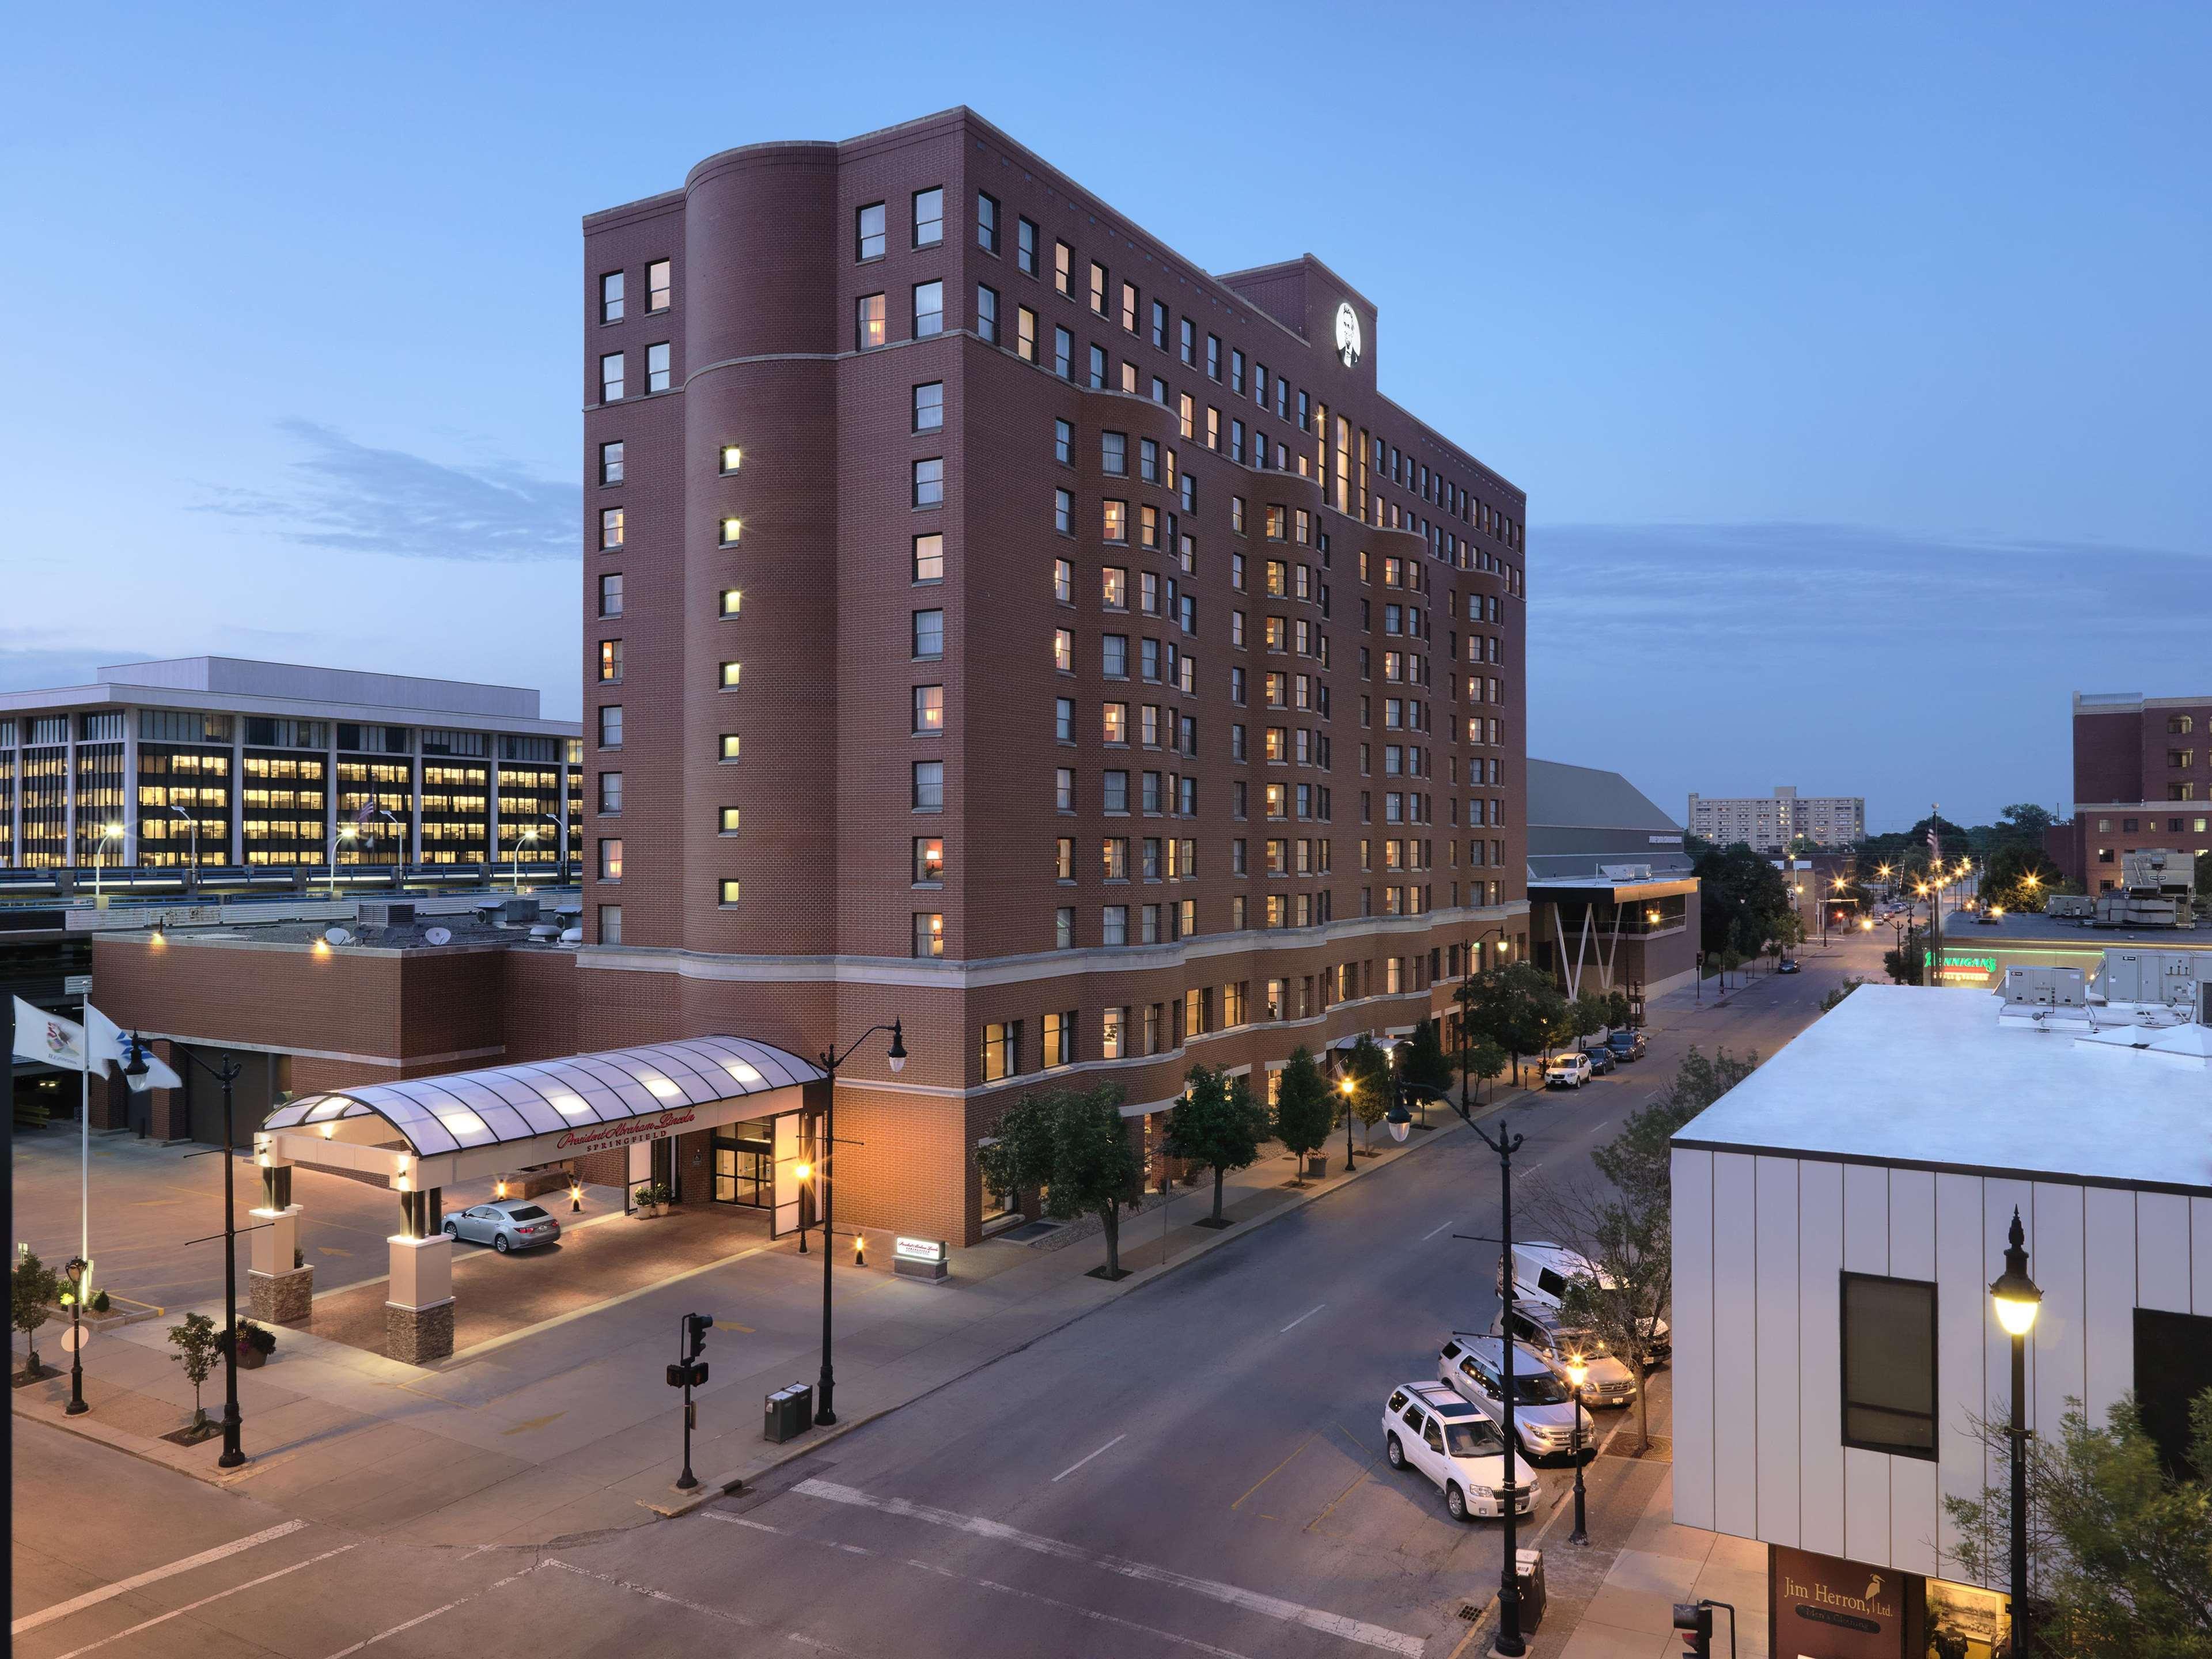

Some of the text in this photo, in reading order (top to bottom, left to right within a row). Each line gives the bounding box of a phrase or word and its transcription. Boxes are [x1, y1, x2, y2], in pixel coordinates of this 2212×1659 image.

[1924, 951, 1997, 973] NNIGAN'S
[557, 1109, 696, 1149] President Abraham Lincoln
[586, 1130, 667, 1152] SPRINGFIELD
[1784, 1577, 1893, 1617] Jim Herron, Ltd.
